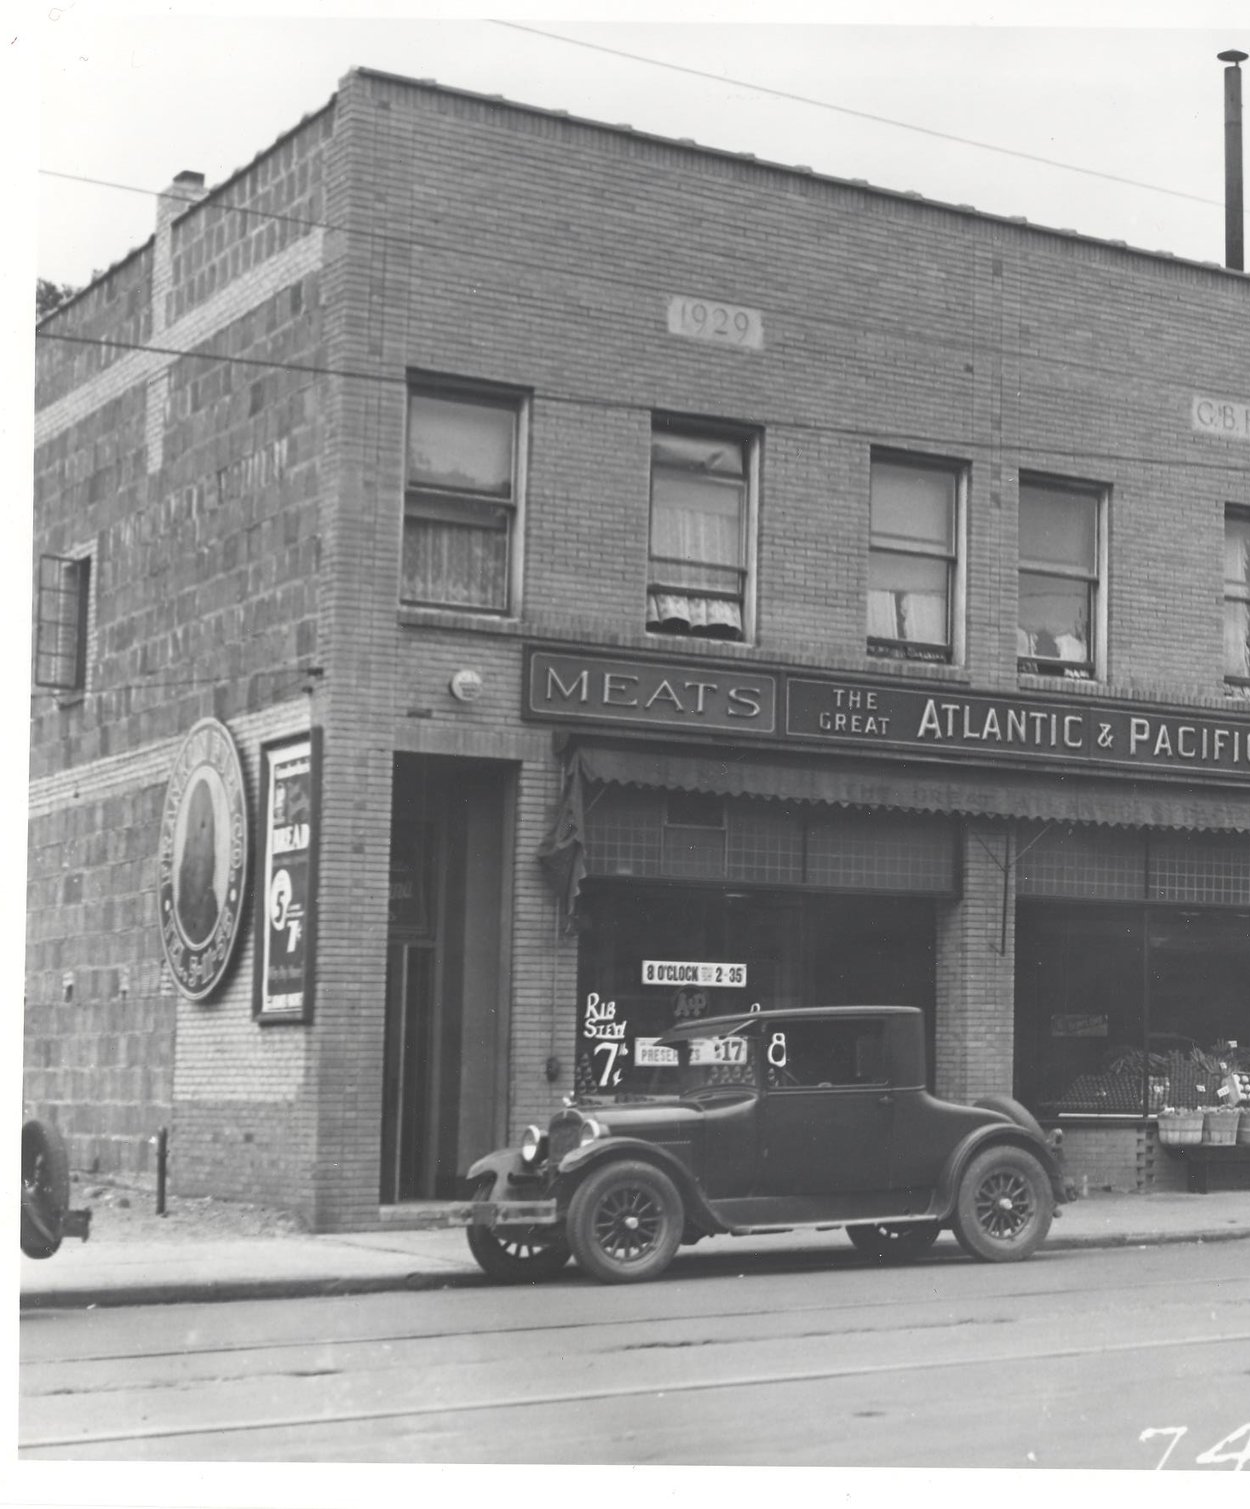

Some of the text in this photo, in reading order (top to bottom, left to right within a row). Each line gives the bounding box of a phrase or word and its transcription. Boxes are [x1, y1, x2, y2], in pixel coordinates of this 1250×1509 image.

[681, 301, 749, 341] 1929
[544, 666, 761, 718] MEATS
[834, 688, 878, 710] THE
[819, 712, 890, 735] GREAT
[917, 699, 1083, 748] ATLANTIC
[1097, 723, 1113, 748] &
[647, 964, 654, 981] 8
[657, 964, 699, 982] O'CLOCK
[715, 967, 722, 983] 2
[729, 968, 742, 983] 35
[584, 992, 616, 1020] RIB
[583, 1018, 627, 1039] STEW
[722, 1041, 743, 1062] 17
